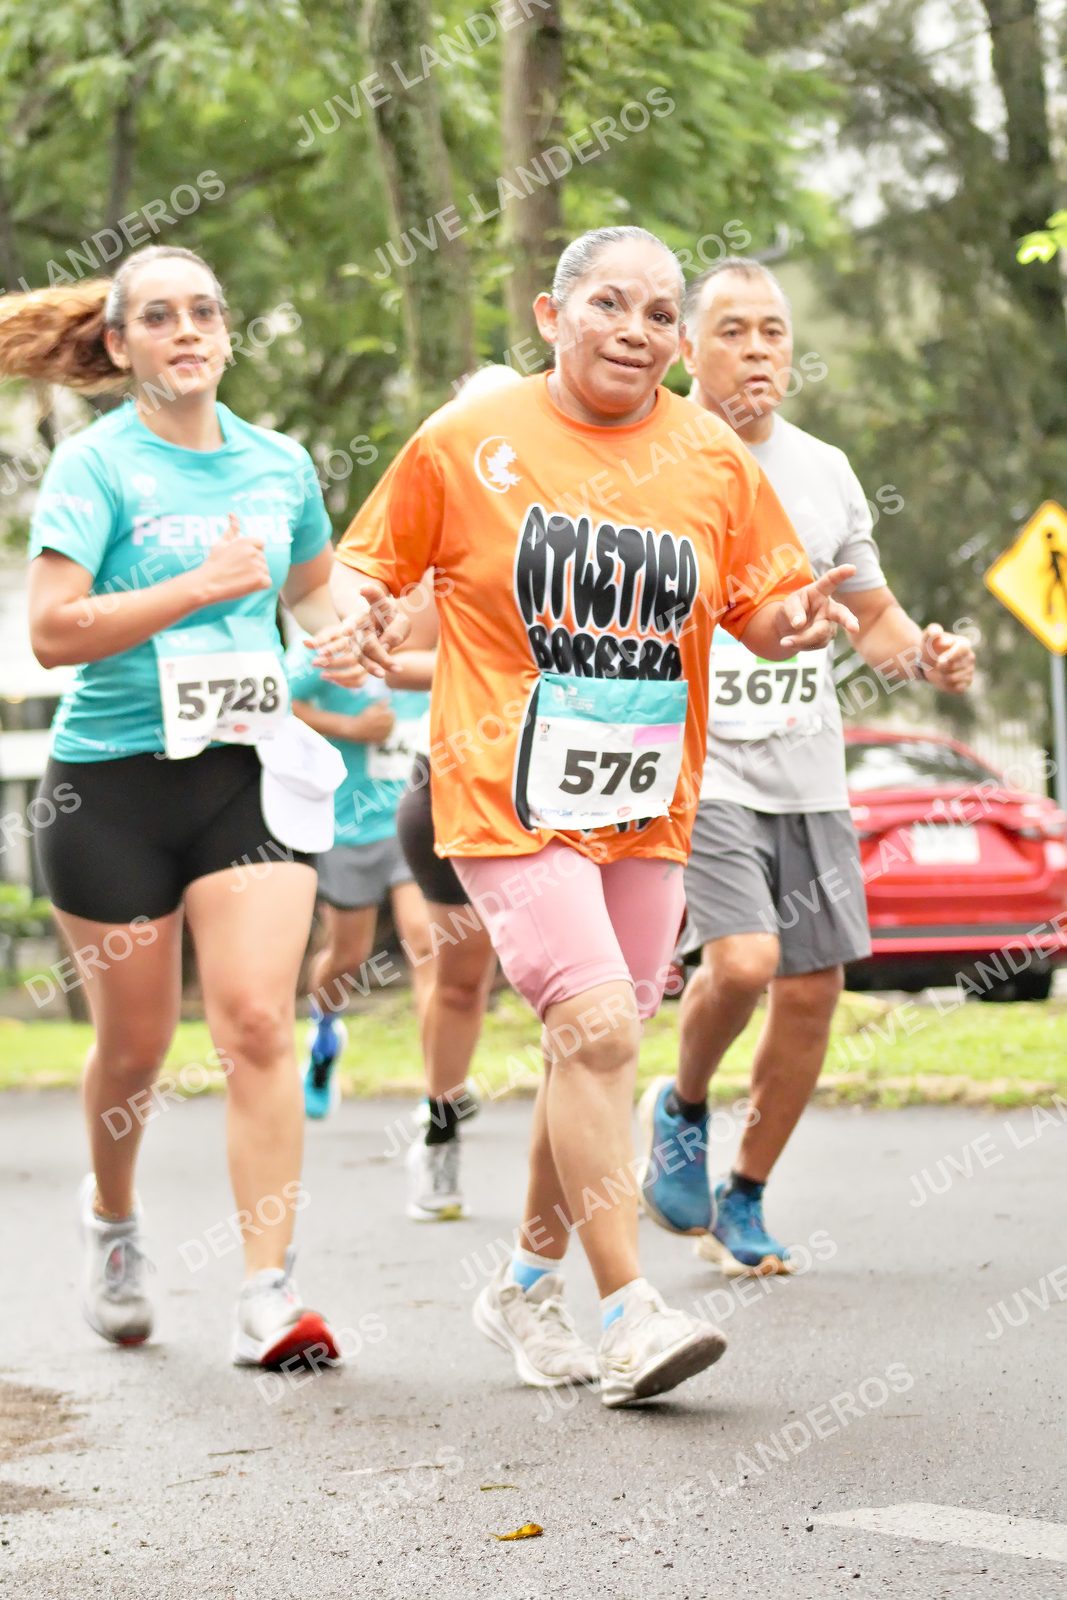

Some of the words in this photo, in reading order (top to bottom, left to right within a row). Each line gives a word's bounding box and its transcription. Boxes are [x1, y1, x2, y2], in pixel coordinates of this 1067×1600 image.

[516, 504, 698, 634] ATLETICO
[177, 676, 280, 721] 5728
[715, 667, 817, 706] 3675
[558, 748, 662, 796] 576
